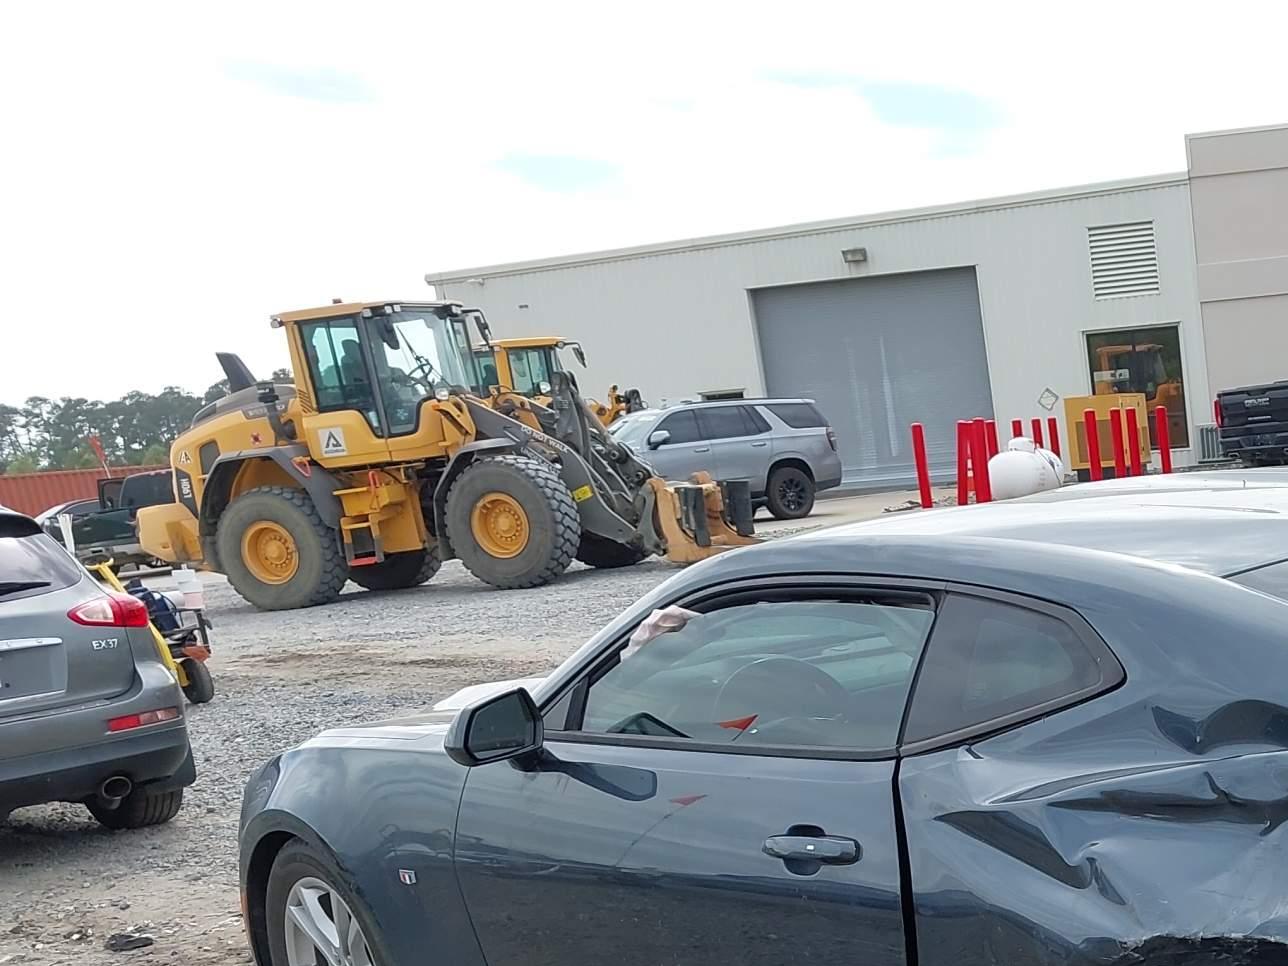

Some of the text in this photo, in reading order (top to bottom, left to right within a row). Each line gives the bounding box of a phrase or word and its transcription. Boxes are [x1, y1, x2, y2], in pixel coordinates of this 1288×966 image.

[521, 426, 568, 453] DO NOT WALK
[180, 478, 193, 498] L90H
